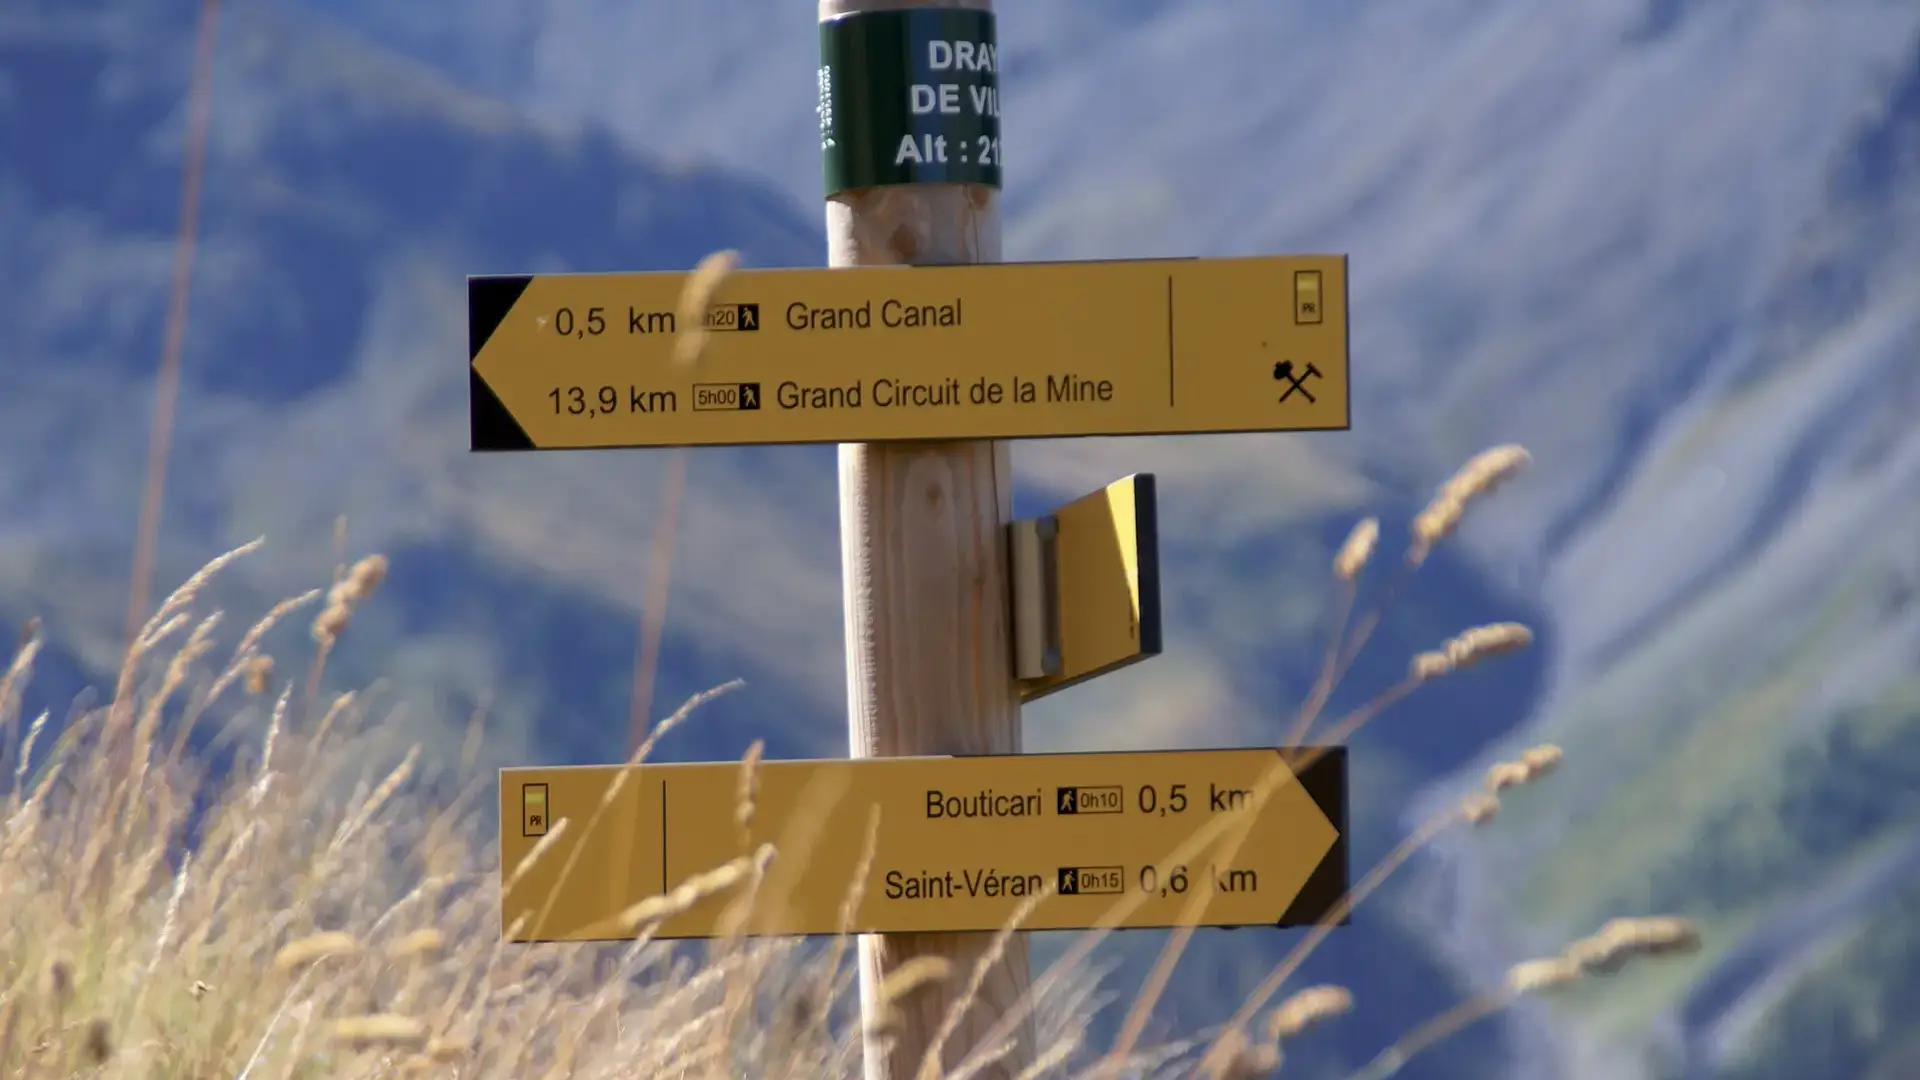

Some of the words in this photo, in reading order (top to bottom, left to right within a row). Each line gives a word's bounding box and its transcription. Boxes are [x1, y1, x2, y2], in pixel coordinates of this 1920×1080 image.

[911, 84, 960, 114] DE
[895, 134, 948, 165] Alt
[555, 308, 605, 340] 0,5
[629, 306, 676, 333] km
[702, 309, 735, 326] h20
[786, 301, 871, 330] Grand
[881, 298, 962, 328] Canal
[1302, 302, 1316, 313] PR
[549, 386, 617, 418] 13,9
[630, 385, 677, 413] km
[698, 389, 736, 405] 5h00
[777, 380, 862, 409] Grand
[872, 377, 960, 406] Circuit
[969, 377, 1003, 404] de
[1013, 376, 1036, 403] la
[1047, 374, 1114, 402] Mine
[926, 789, 1042, 819] Bouticari
[1080, 793, 1118, 808] 0h10
[1138, 785, 1188, 817] 0,5
[1210, 783, 1253, 812] km
[530, 815, 542, 826] PR
[885, 870, 1043, 900] Saint-Véran
[1081, 873, 1120, 889] 0h15
[1140, 865, 1188, 898] 0,6
[1211, 864, 1257, 892] km
